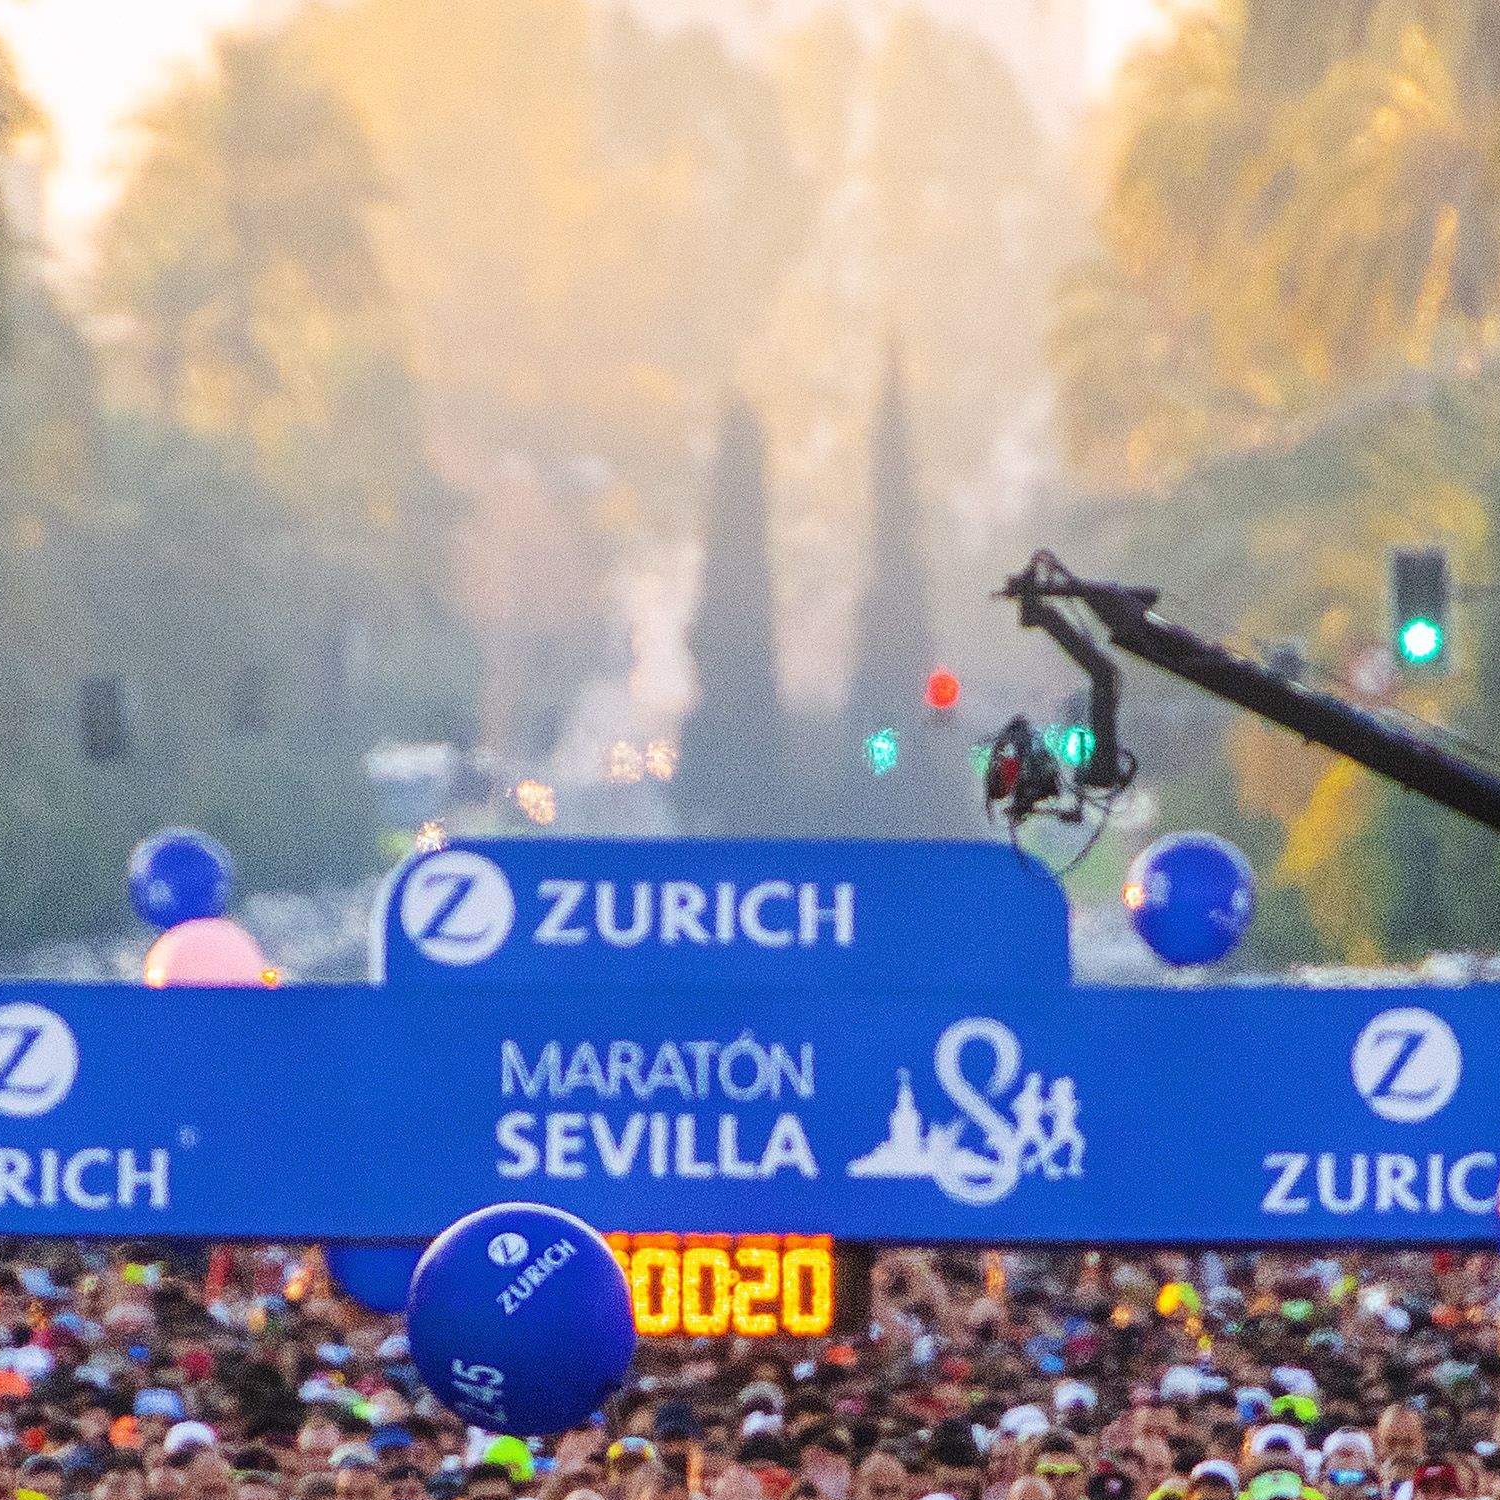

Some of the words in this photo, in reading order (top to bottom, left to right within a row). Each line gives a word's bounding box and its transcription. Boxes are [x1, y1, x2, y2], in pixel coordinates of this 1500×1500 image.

[534, 880, 855, 947] ZURICH
[501, 1031, 816, 1100] MARATÓN
[495, 1111, 819, 1180] SEVILLA
[496, 1238, 578, 1315] ZURICH
